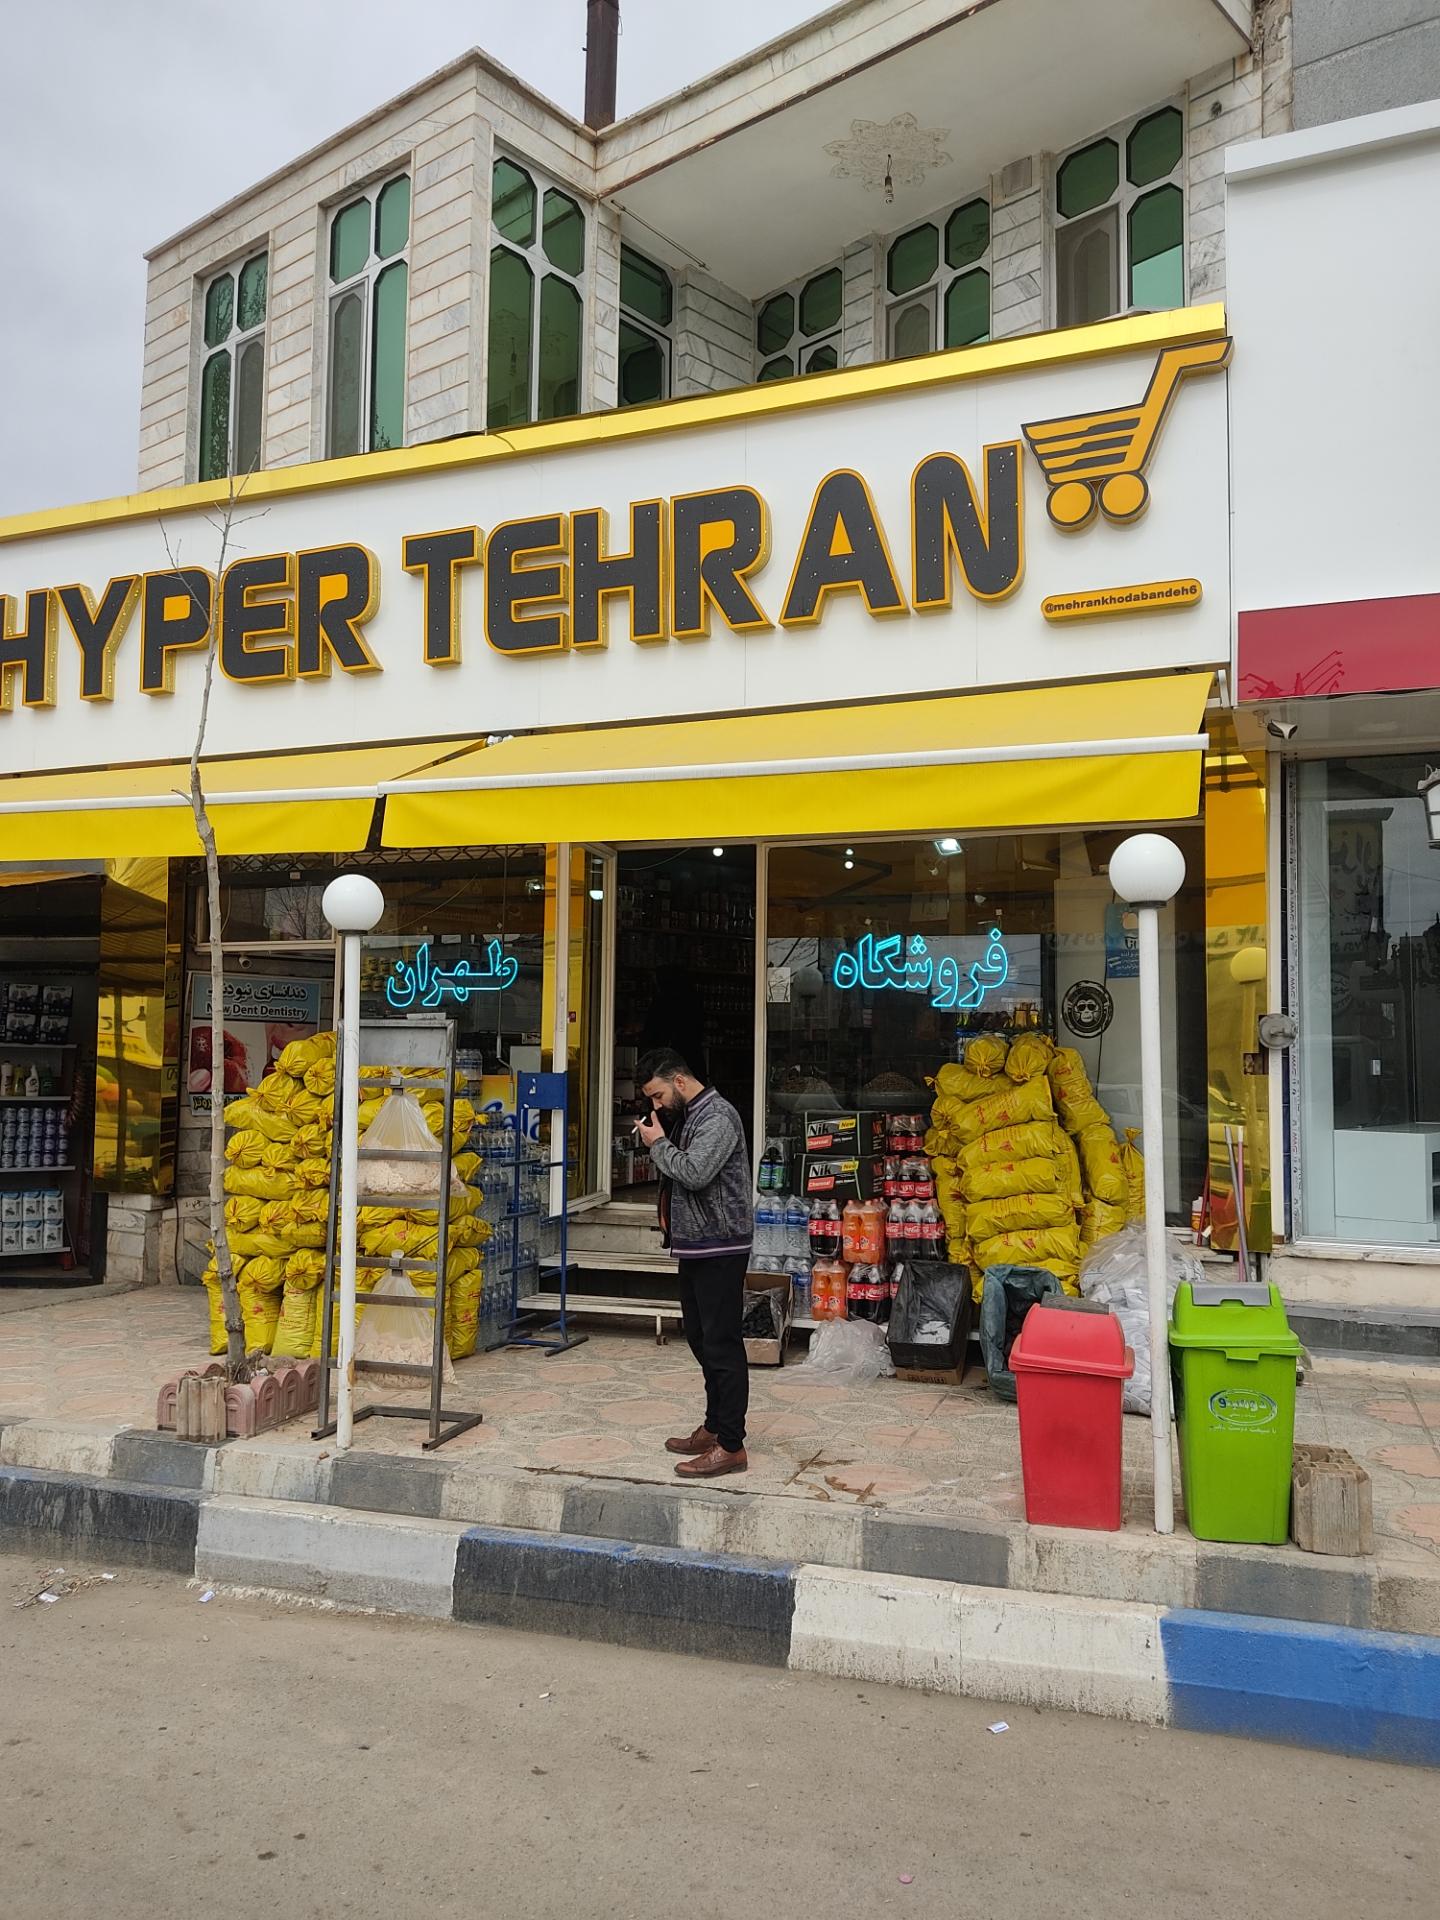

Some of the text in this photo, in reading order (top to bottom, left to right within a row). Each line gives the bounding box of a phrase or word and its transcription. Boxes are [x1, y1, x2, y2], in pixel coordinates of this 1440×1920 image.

[0, 439, 1026, 712] HYPER TEHRAN
[1044, 585, 1198, 613] @mehrankhodabandeh6
[387, 939, 519, 1007] طهران
[834, 928, 1009, 1008] فروشگاه
[207, 982, 308, 1001] دندانسازی نیودن
[206, 1002, 308, 1020] Nw Dent Dentistry
[808, 1122, 830, 1137] Nik
[810, 1163, 832, 1178] Nik
